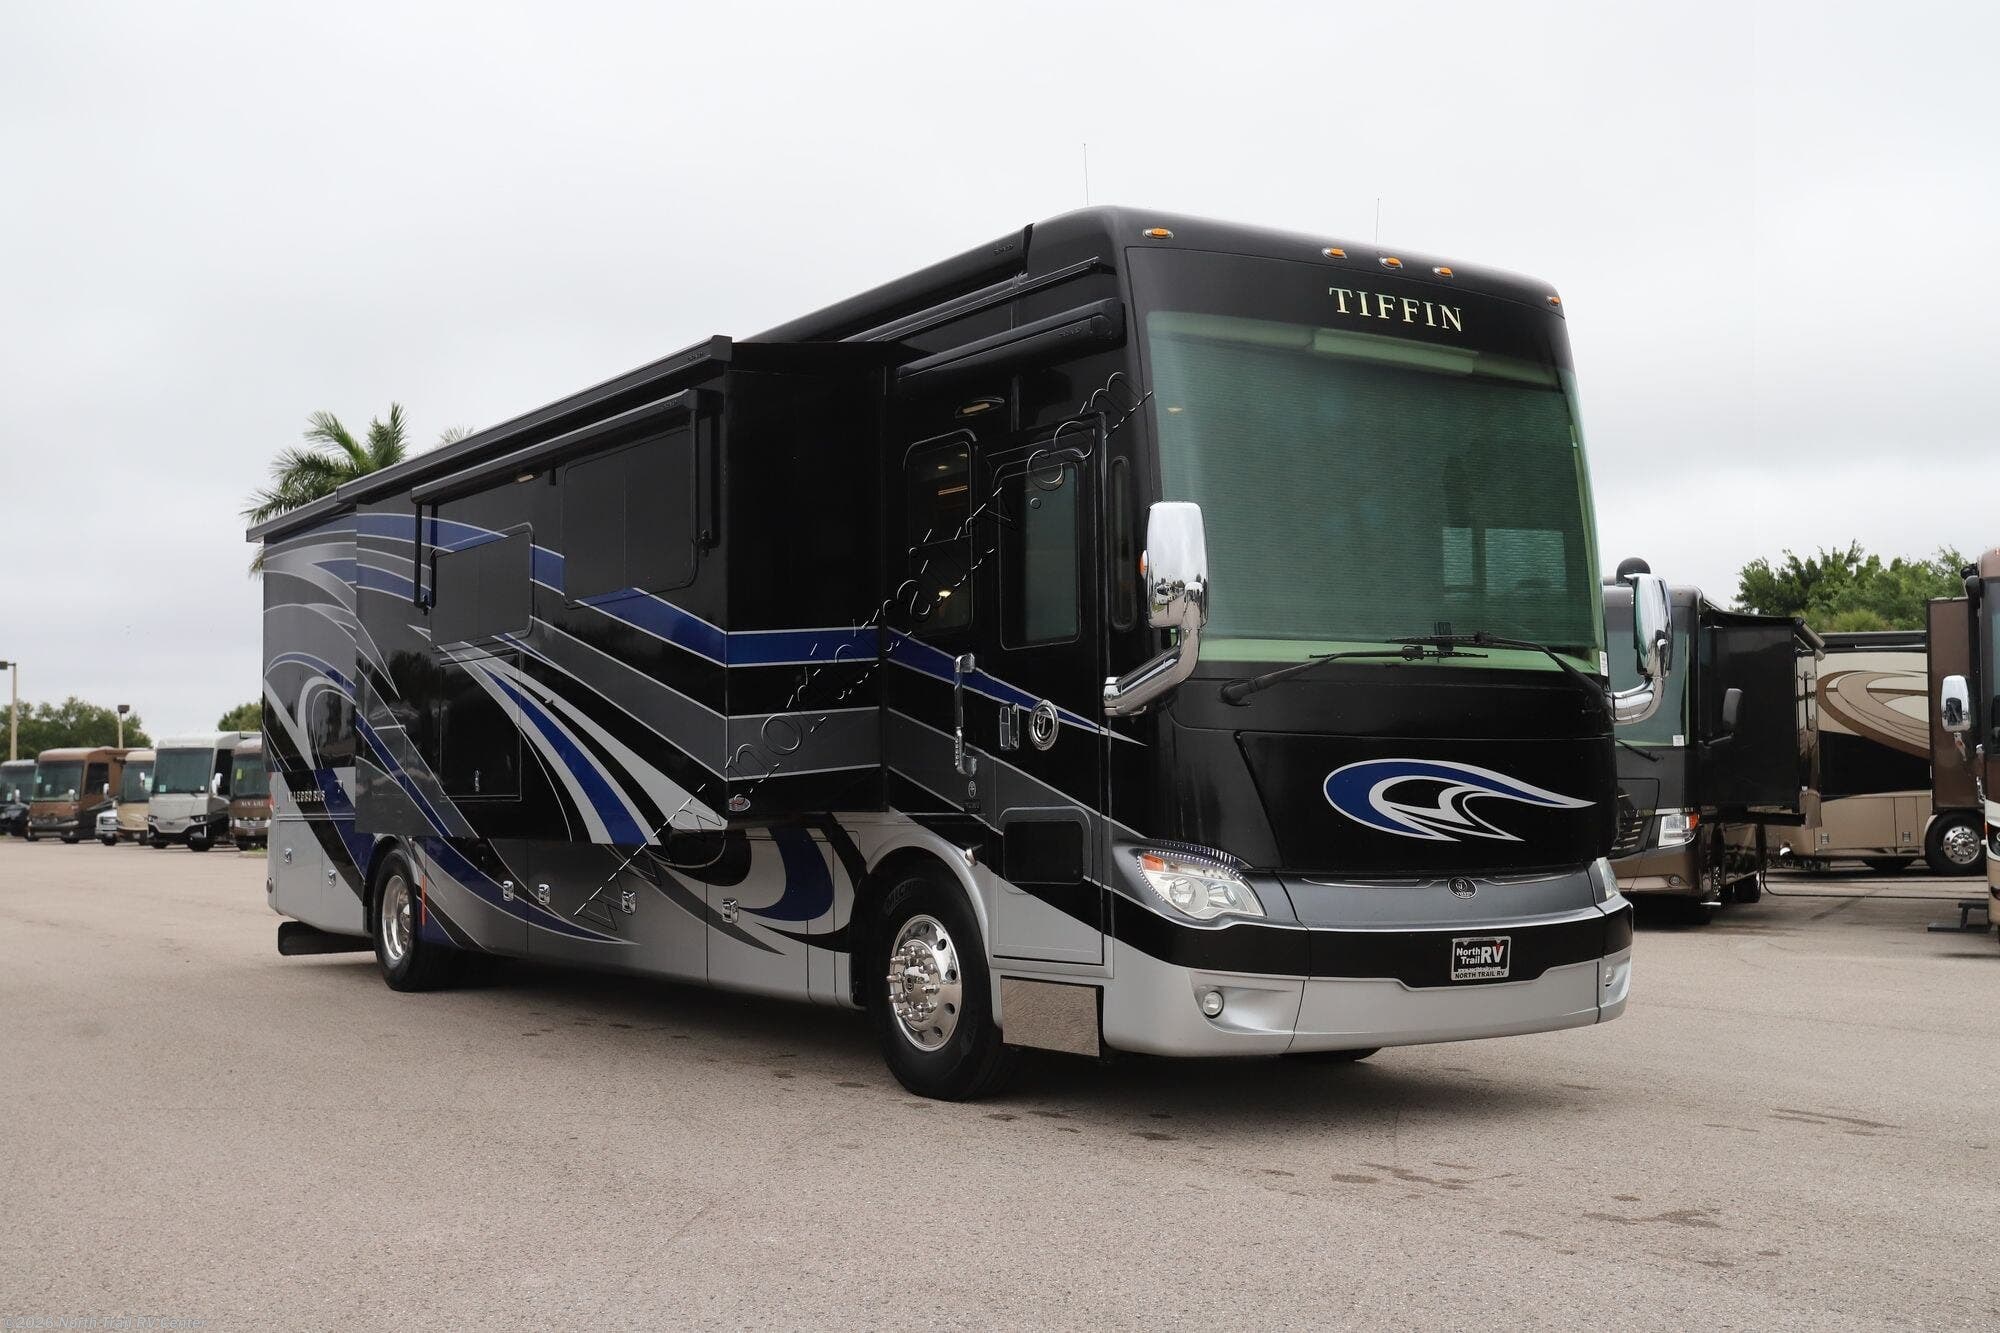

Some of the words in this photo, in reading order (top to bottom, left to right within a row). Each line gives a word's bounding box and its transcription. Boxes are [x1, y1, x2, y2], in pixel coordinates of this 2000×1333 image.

[1329, 287, 1462, 332] TIFFIN
[1456, 947, 1480, 956] North
[1480, 946, 1504, 964] RV
[1461, 956, 1480, 965] Trail
